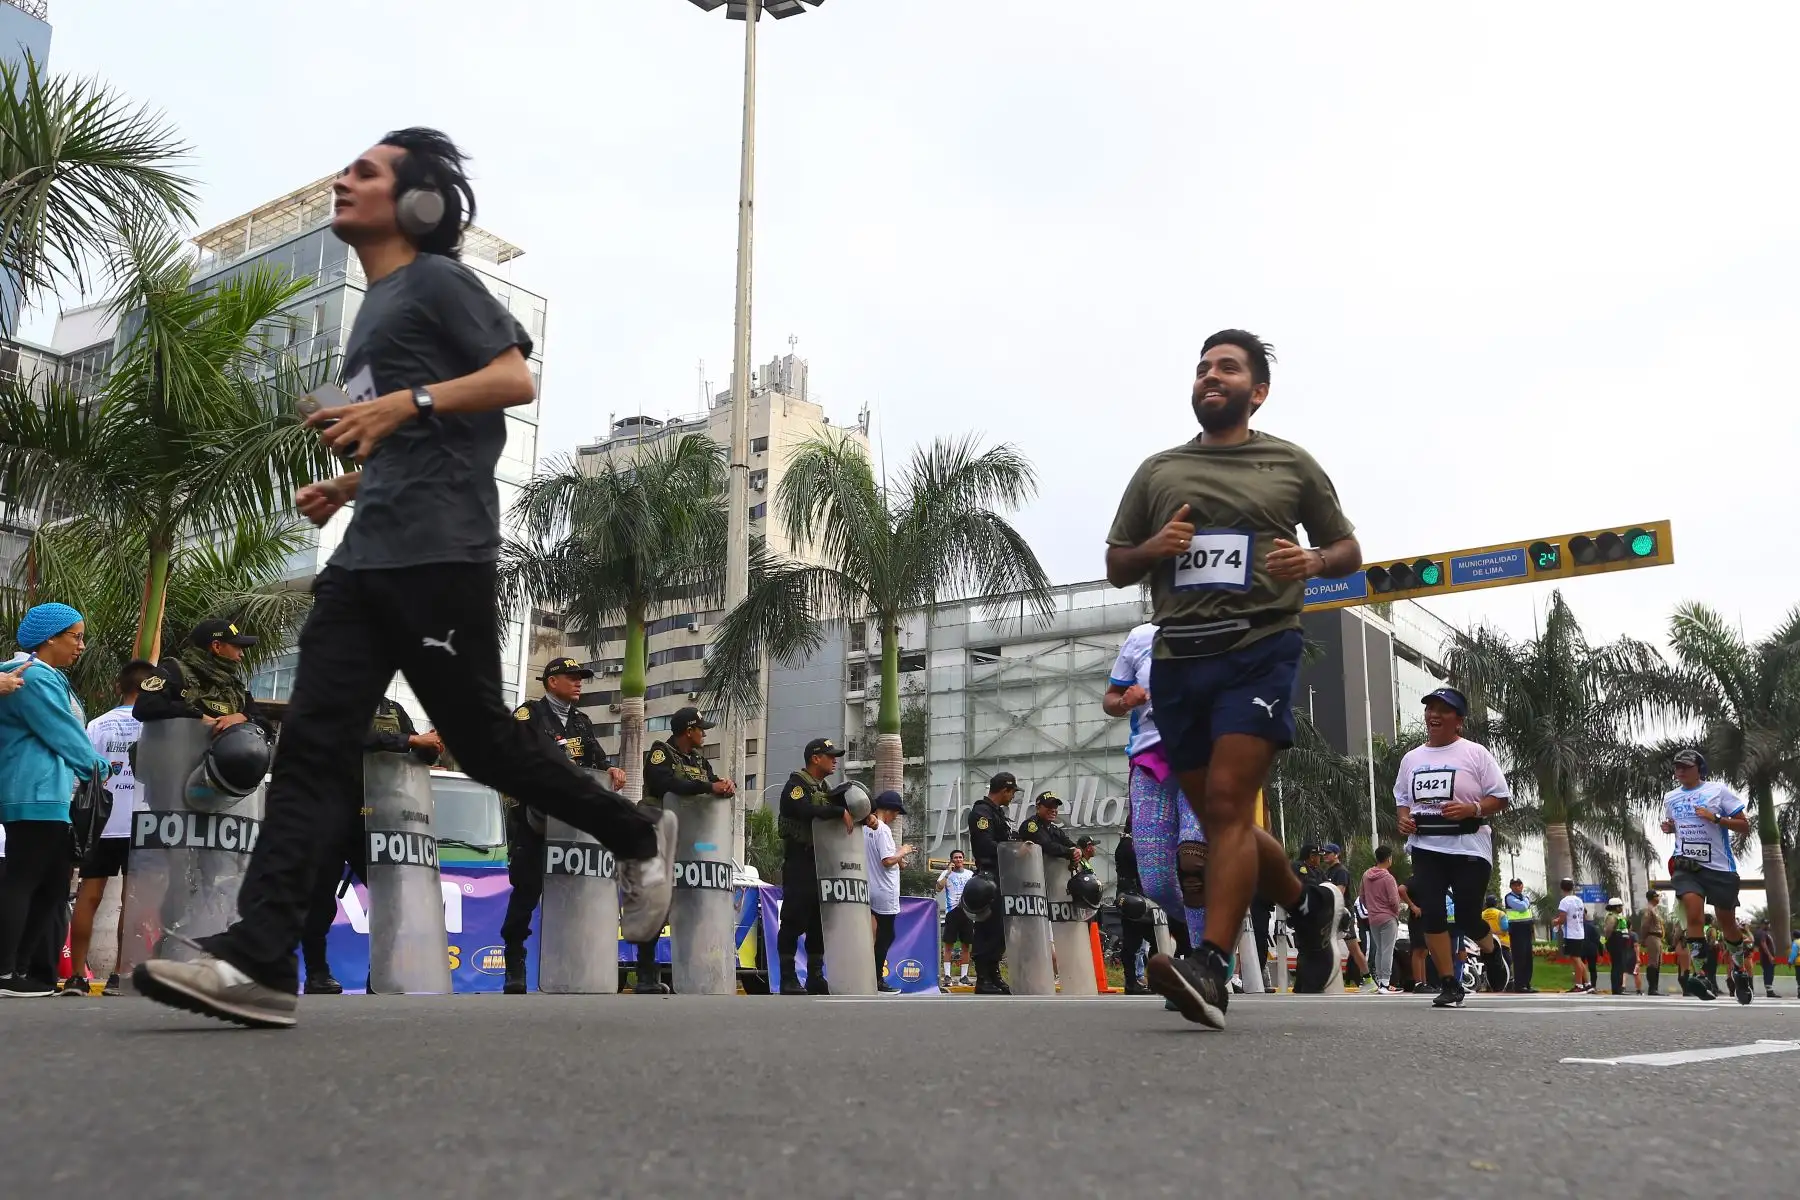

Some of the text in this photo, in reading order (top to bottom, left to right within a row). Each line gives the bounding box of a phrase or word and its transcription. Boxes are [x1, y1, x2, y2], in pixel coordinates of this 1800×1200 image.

[1179, 549, 1242, 570] 2074
[1458, 554, 1517, 569] MUNICIPALIDAD
[1539, 552, 1555, 566] 24
[1485, 566, 1503, 575] LIMA
[1320, 582, 1349, 594] PALMA
[1416, 779, 1447, 791] 3421
[924, 775, 1128, 853] fablla
[370, 832, 439, 867] POLICI
[1684, 848, 1708, 857] 3625
[546, 845, 615, 878] POLIC
[820, 879, 870, 902] POLICI
